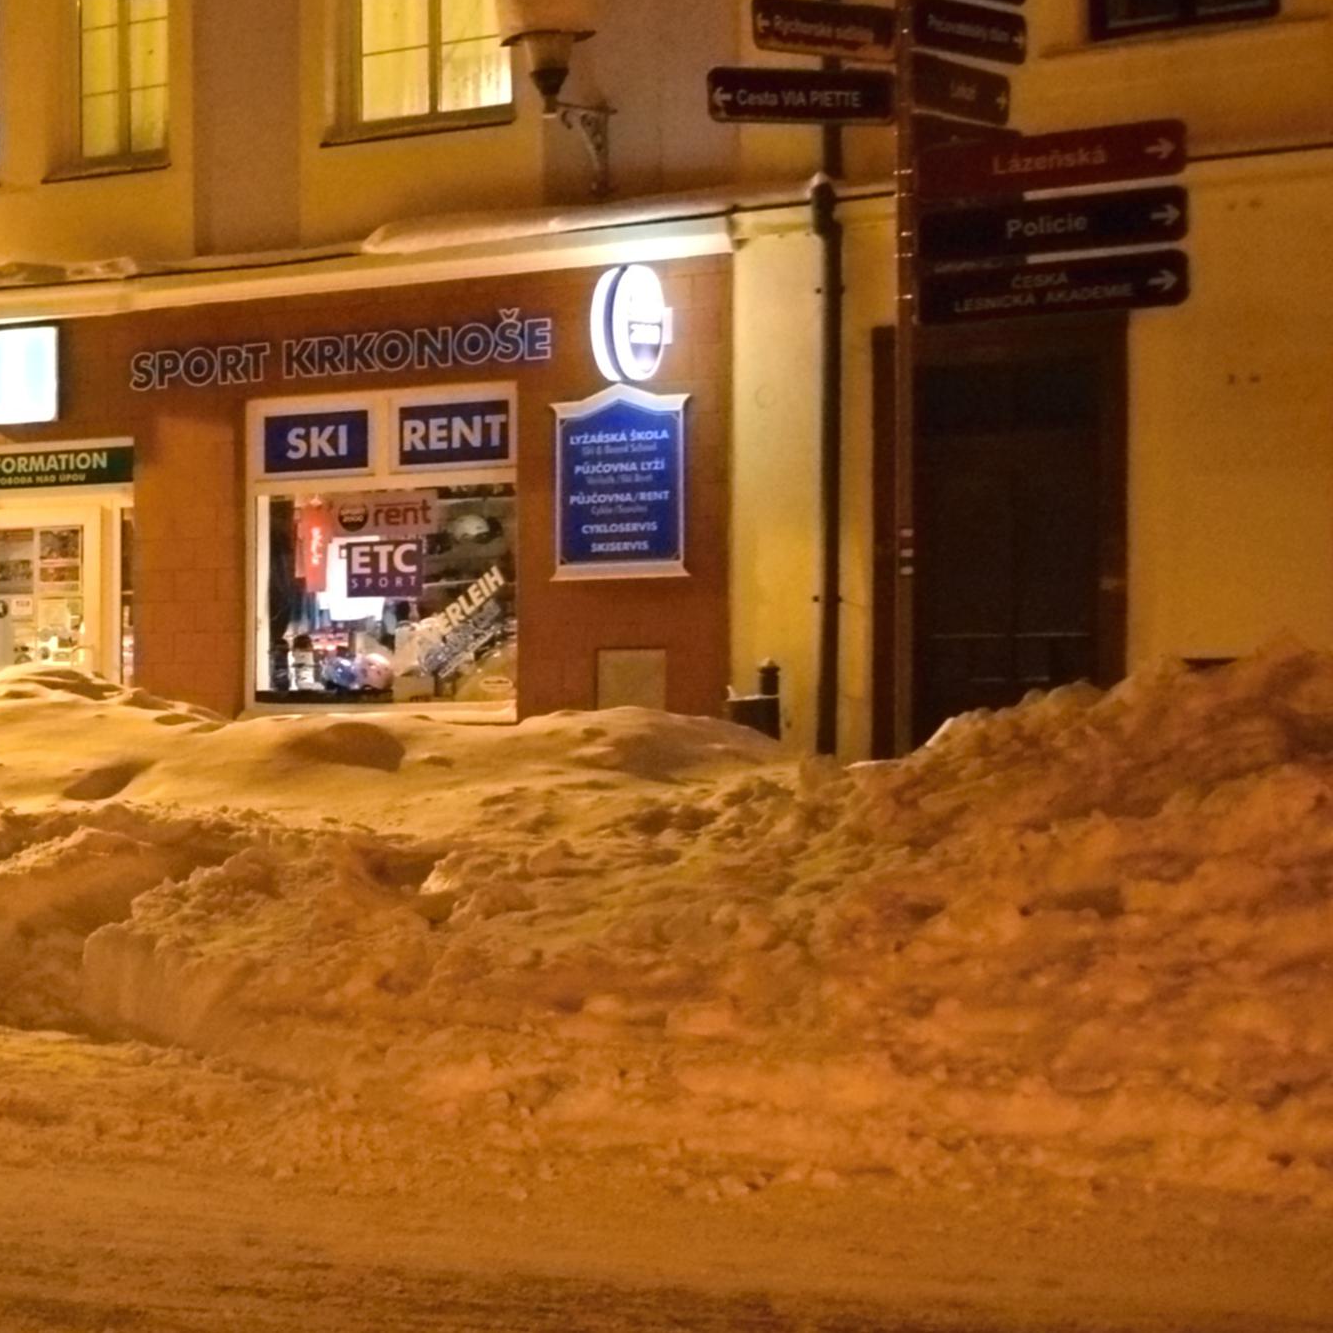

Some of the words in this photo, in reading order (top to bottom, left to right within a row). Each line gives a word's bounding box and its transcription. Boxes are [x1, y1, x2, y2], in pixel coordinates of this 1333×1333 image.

[736, 89, 778, 106] Cesta
[781, 91, 806, 106] VIA
[809, 91, 862, 108] PIETTE
[1006, 215, 1088, 239] Policie
[129, 342, 270, 392] SPORT
[282, 308, 553, 380] KRKONOŠE
[286, 423, 348, 460] SKI
[402, 414, 507, 453] RENT
[35, 474, 56, 484] NAD
[373, 499, 432, 528] rent
[581, 521, 658, 534] CYKLOSERVIS
[591, 540, 650, 553] SKISERVIS
[350, 543, 419, 575] ETC
[351, 575, 418, 588] SPORT
